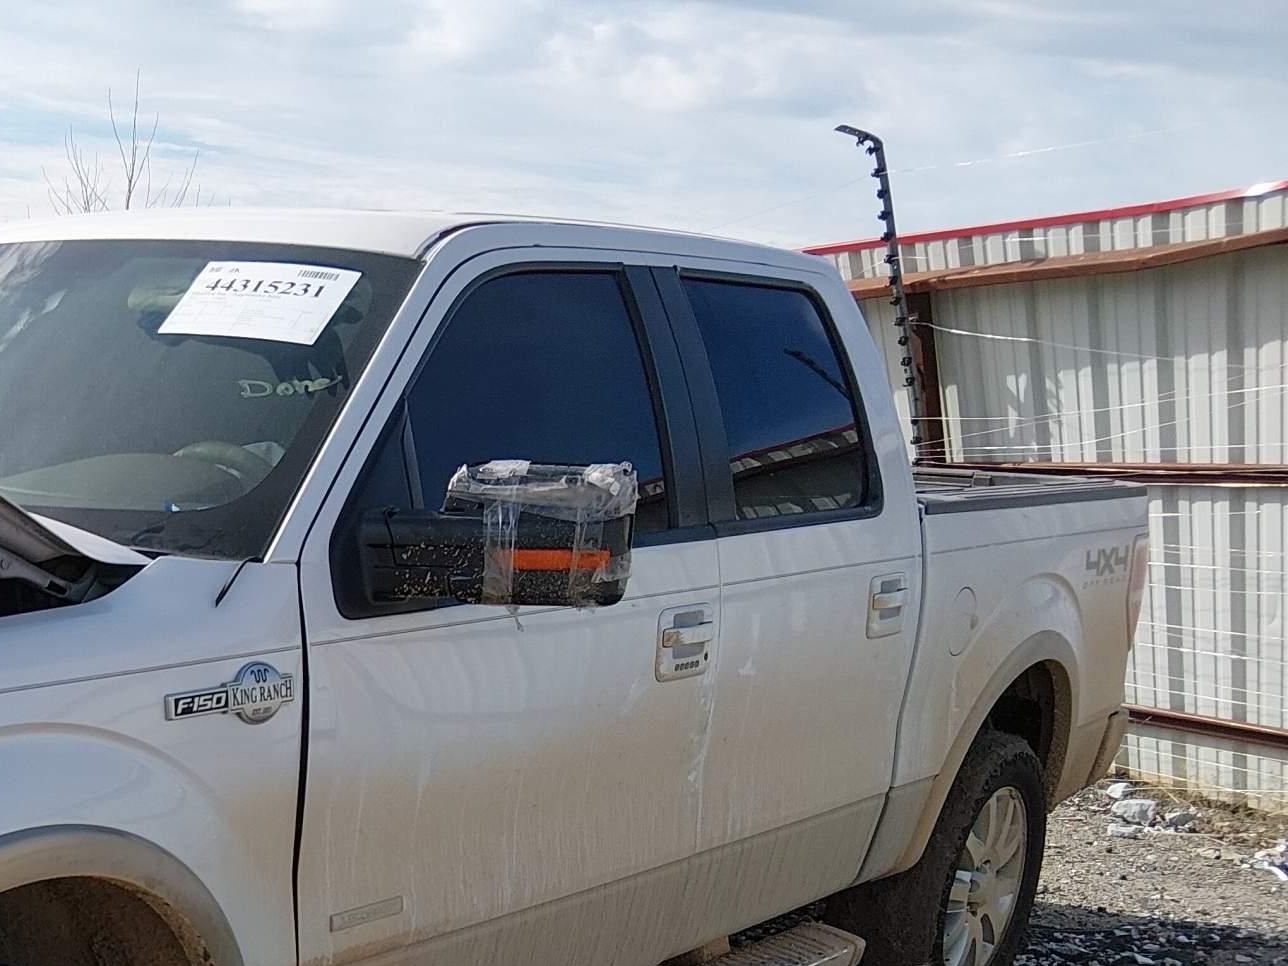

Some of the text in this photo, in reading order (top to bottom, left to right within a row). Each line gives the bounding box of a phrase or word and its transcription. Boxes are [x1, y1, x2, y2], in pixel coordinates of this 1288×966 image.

[205, 278, 326, 298] 44315231
[231, 679, 292, 706] KING RANCH
